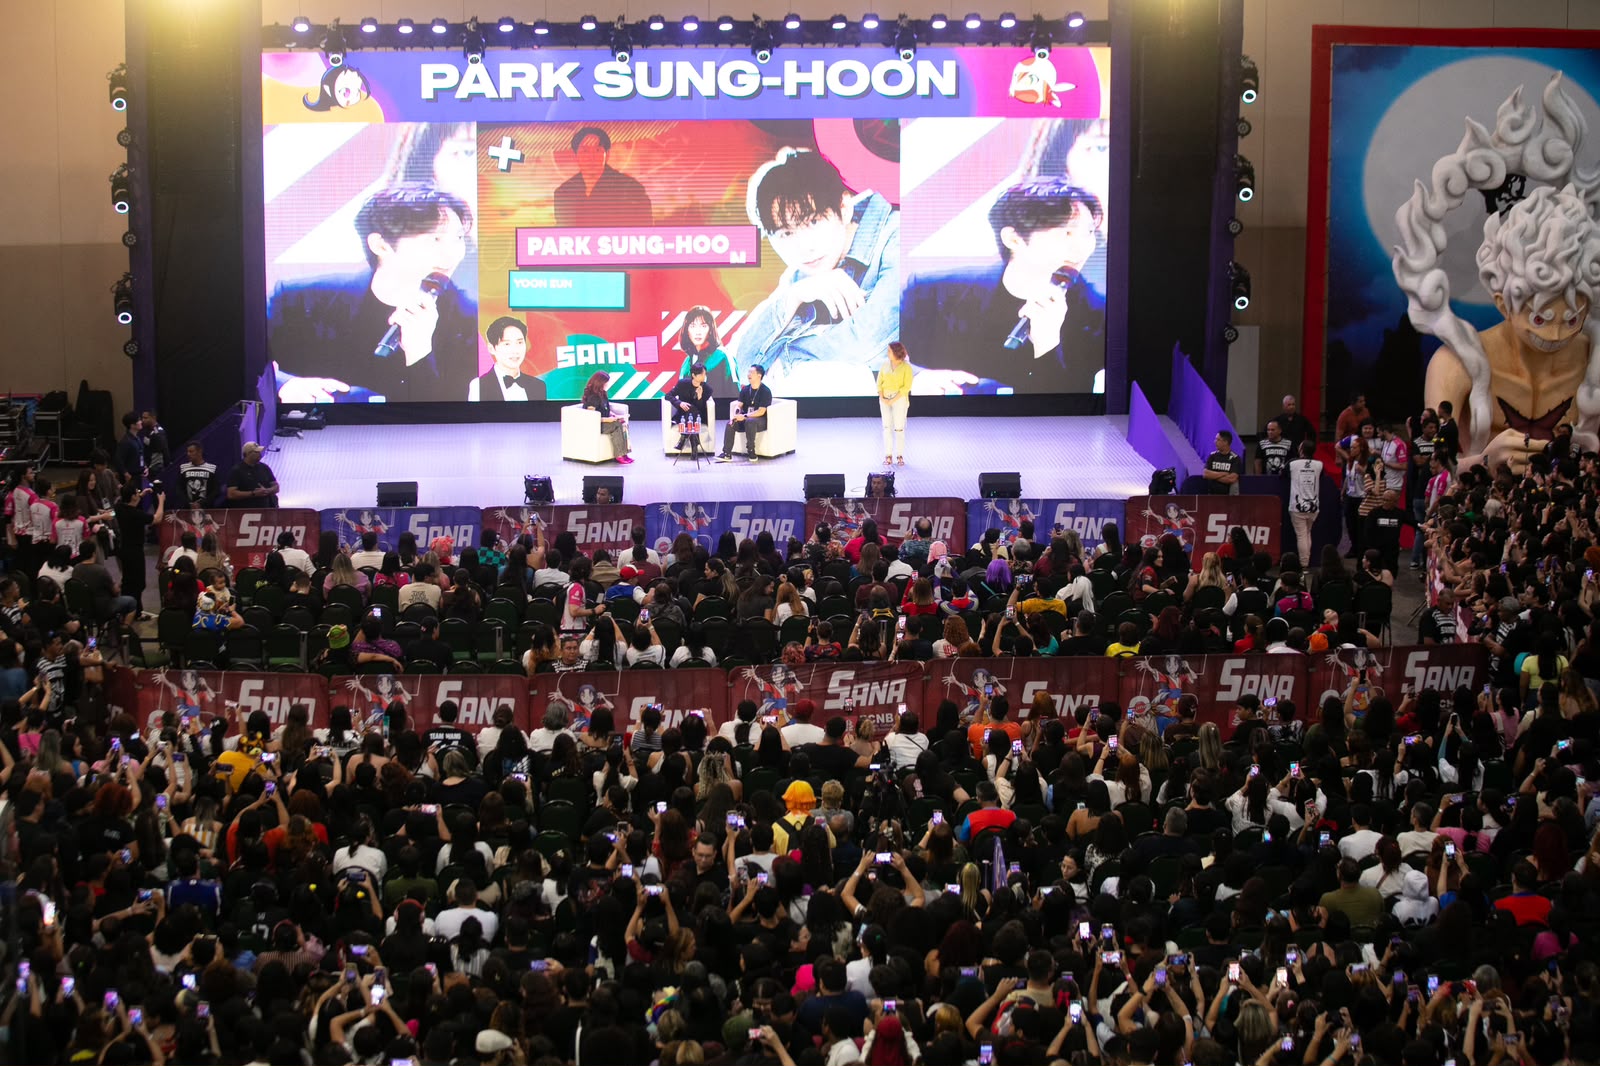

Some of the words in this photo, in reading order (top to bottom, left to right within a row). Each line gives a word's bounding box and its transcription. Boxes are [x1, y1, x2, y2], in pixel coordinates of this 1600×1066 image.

[420, 61, 581, 100] PARK
[593, 59, 957, 99] SUNG-HOON
[527, 235, 592, 256] PARK
[236, 513, 306, 547] SANA
[566, 510, 633, 544] SANA
[823, 670, 908, 710] SANA
[1215, 658, 1296, 702] SANA
[1400, 651, 1476, 694] SANA
